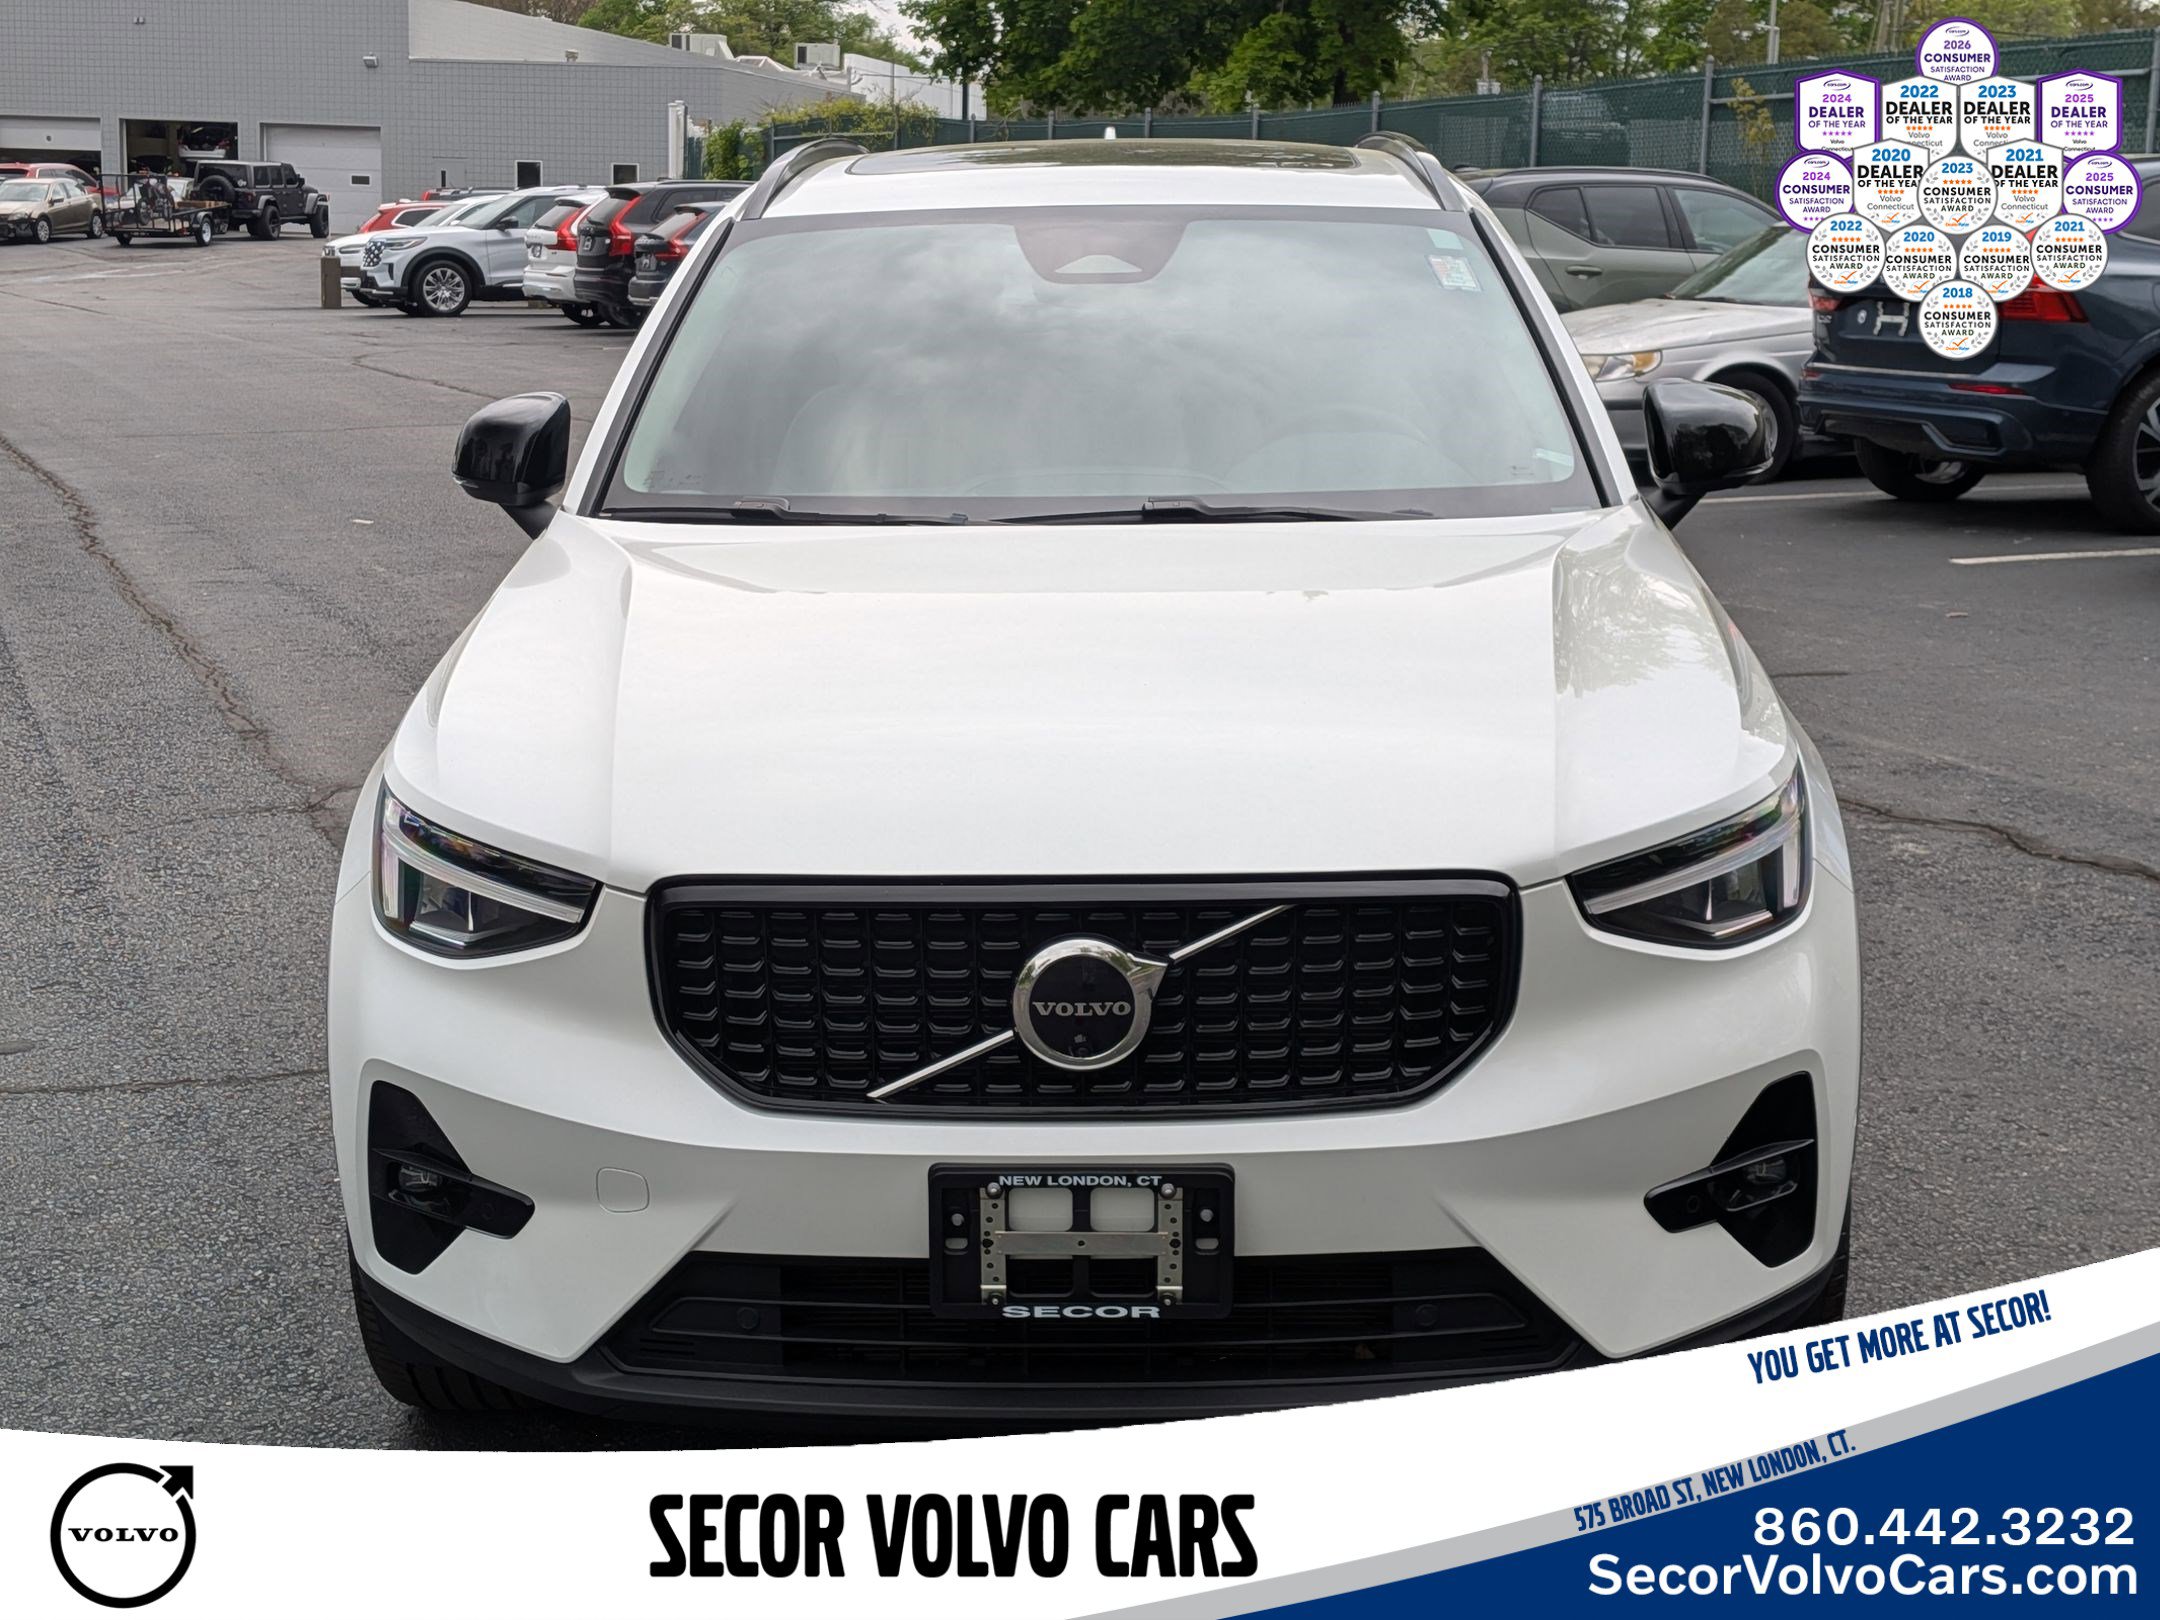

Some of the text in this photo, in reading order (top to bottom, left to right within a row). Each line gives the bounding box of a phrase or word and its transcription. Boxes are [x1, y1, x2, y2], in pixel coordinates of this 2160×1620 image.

[1033, 1001, 1131, 1016] VOLVO
[999, 1176, 1162, 1187] NEW LONDON, CT
[1003, 1306, 1160, 1318] SECOR
